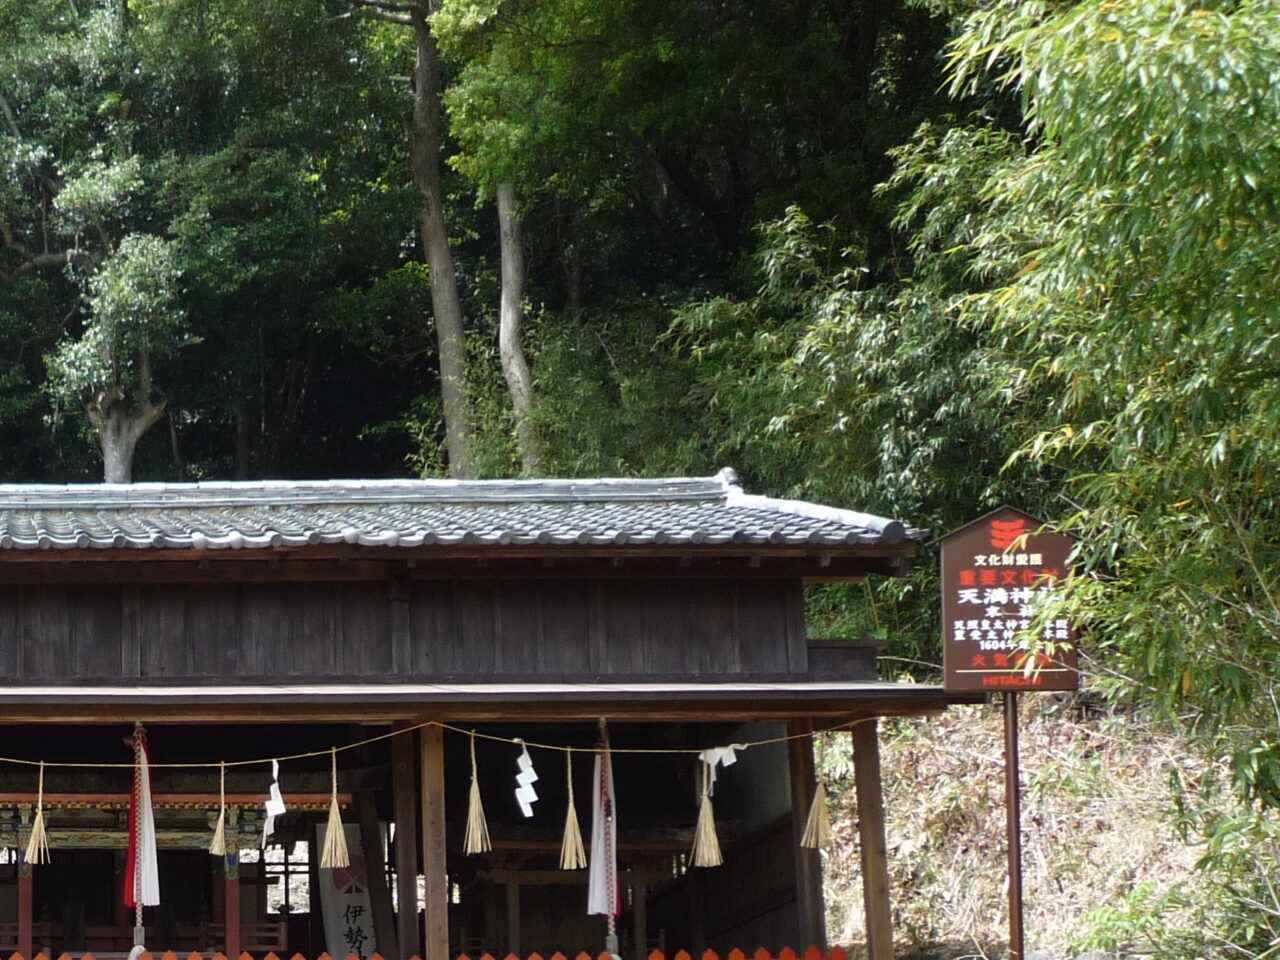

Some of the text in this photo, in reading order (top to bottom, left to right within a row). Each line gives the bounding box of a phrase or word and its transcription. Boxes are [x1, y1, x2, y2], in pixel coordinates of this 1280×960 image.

[954, 630, 1030, 640] 豊受太神
[982, 675, 1042, 686] HITACHI
